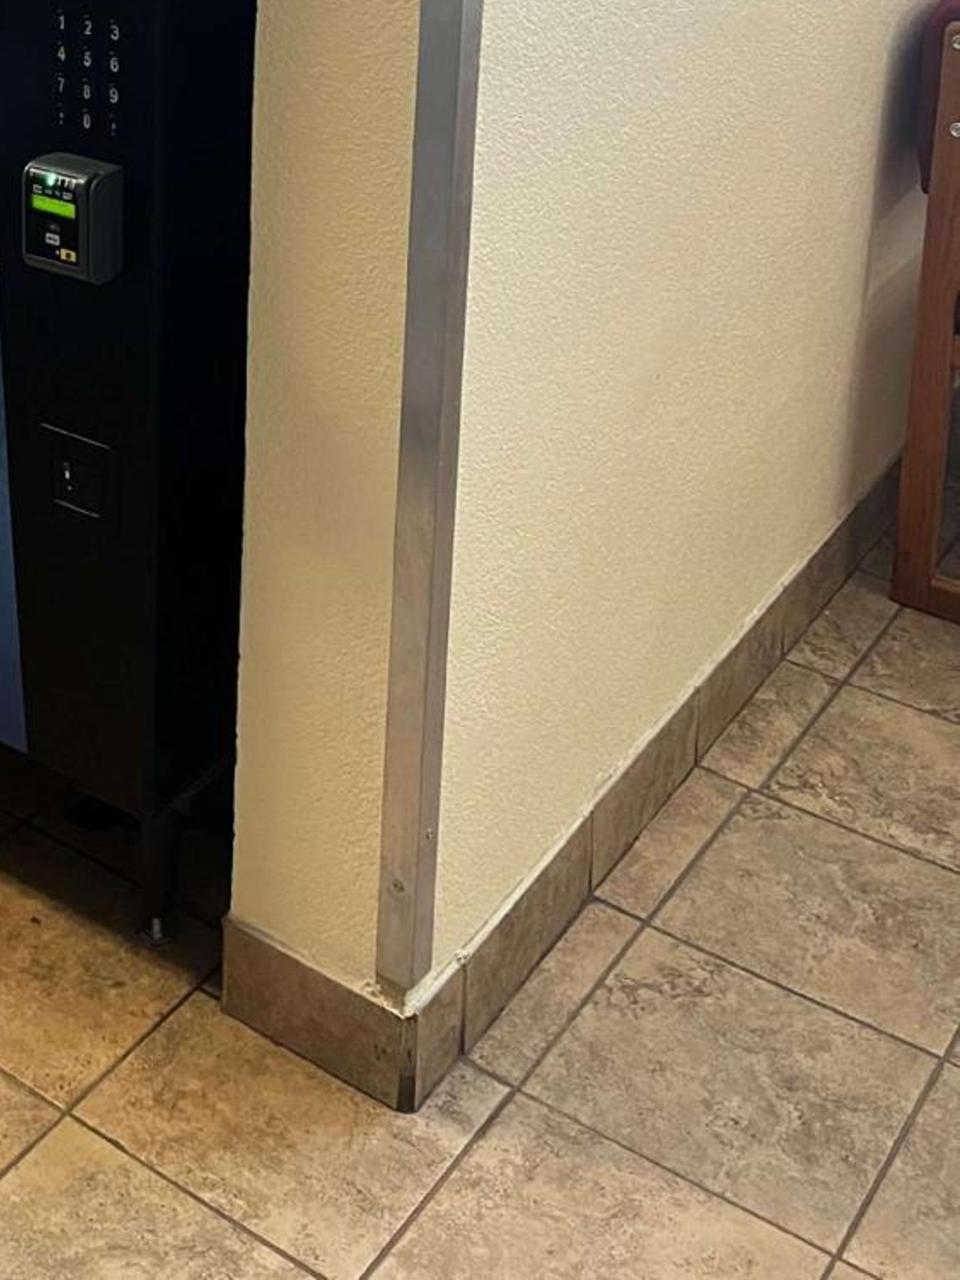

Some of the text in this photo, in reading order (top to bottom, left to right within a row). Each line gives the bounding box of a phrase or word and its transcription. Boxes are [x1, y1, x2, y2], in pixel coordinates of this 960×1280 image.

[83, 20, 93, 35] 2
[110, 24, 119, 41] 3
[57, 45, 119, 73] 4 5 6
[57, 76, 119, 104] 7 8 9
[83, 113, 91, 129] 0
